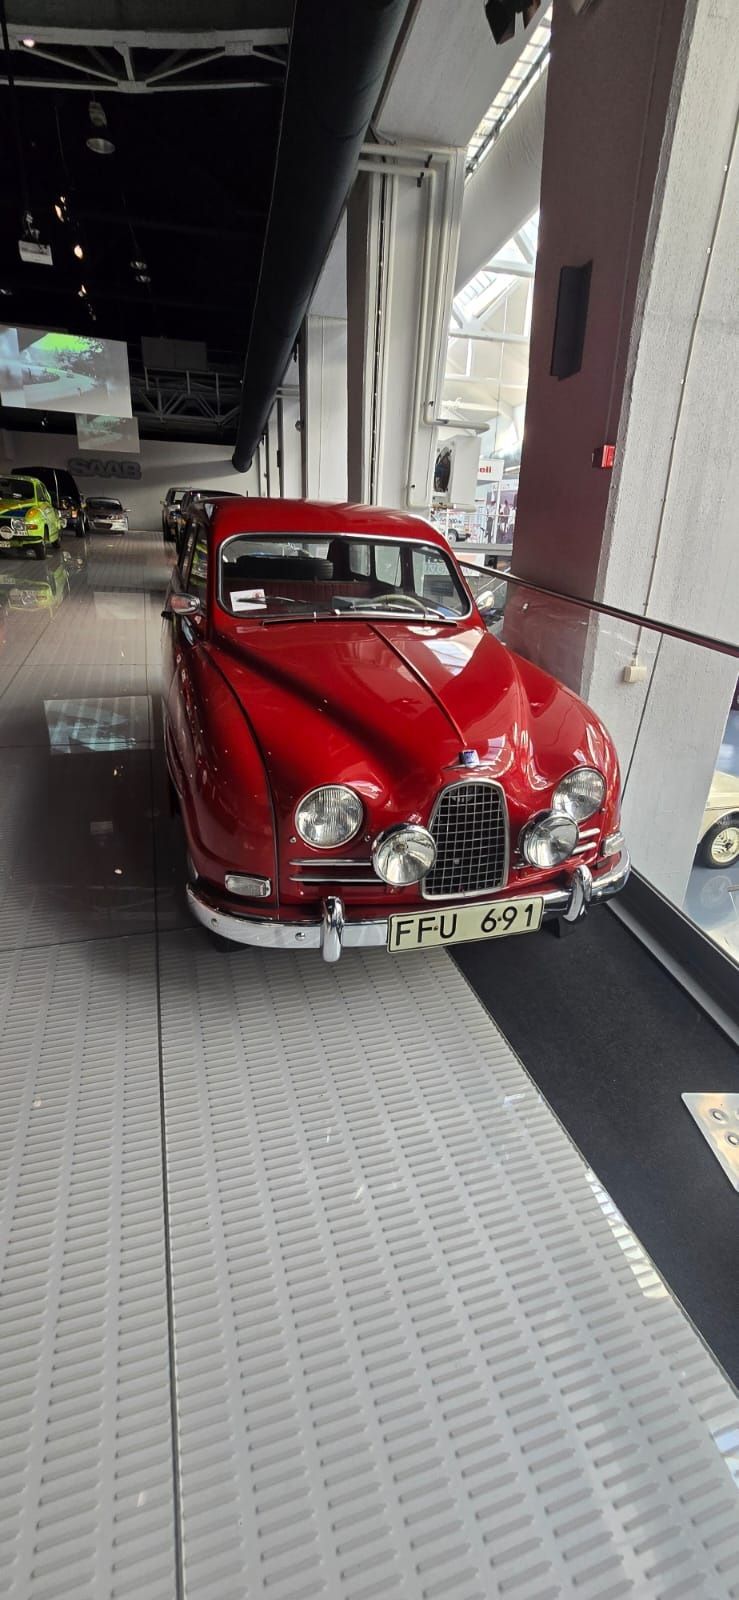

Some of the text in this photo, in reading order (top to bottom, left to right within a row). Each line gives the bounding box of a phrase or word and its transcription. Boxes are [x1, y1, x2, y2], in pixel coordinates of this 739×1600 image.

[68, 458, 142, 480] SAAB
[396, 904, 533, 945] FFU 691
